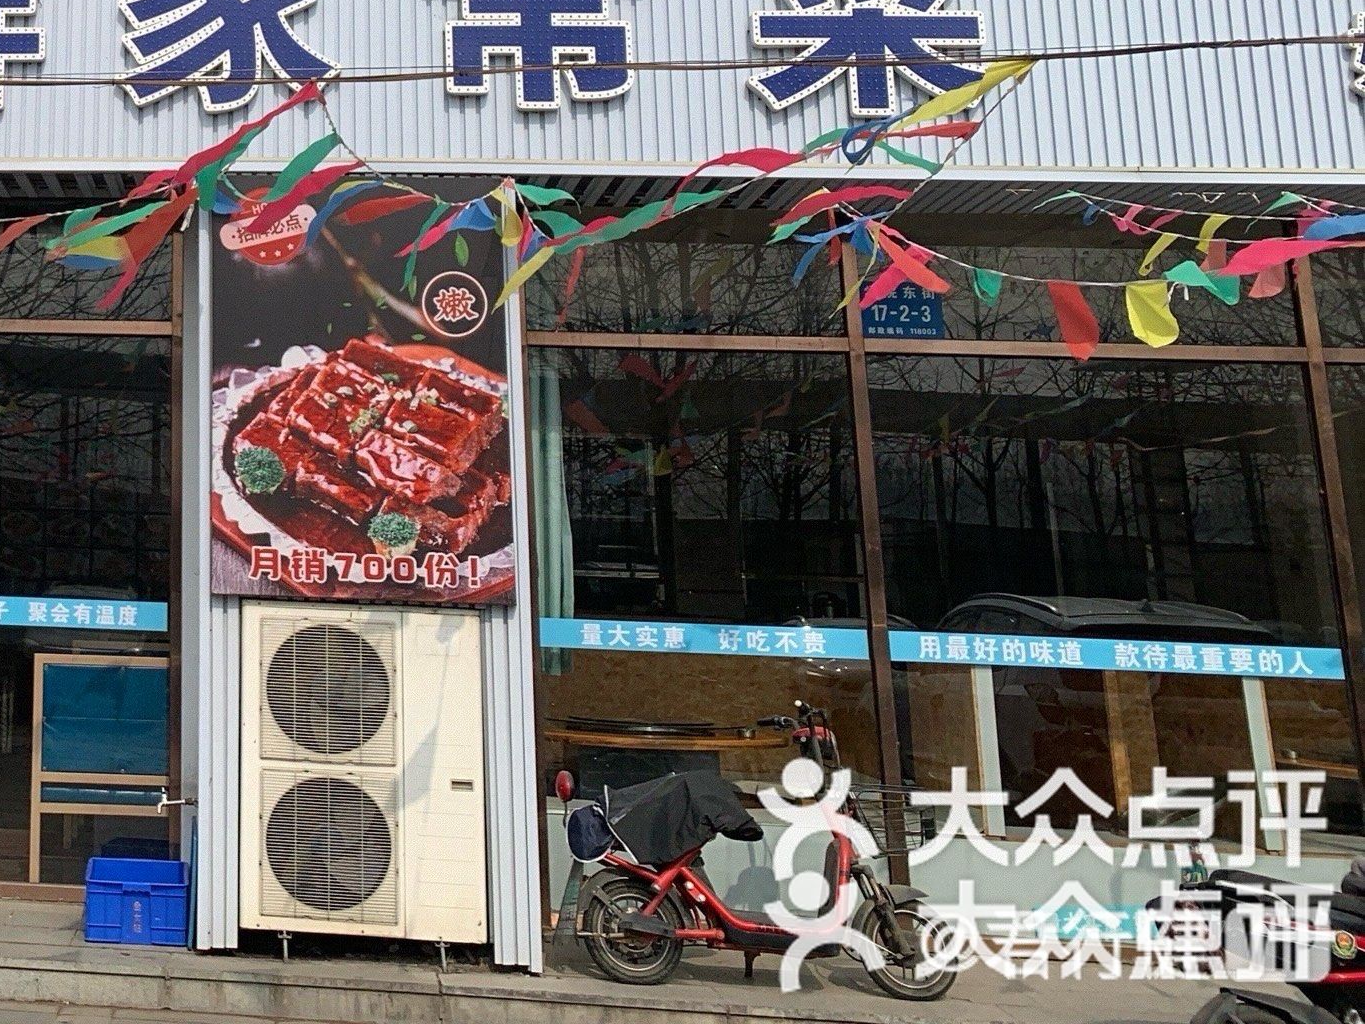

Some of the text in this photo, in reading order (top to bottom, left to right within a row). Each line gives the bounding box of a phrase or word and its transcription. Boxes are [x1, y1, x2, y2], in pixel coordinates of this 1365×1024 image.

[434, 287, 480, 322] 嫩
[870, 304, 932, 323] 17-2-3
[28, 602, 139, 627] 聚会有温度
[580, 624, 827, 655] 量大实惠 好吃不贵
[918, 634, 1315, 676] 用最好的味道 款待最重要的人
